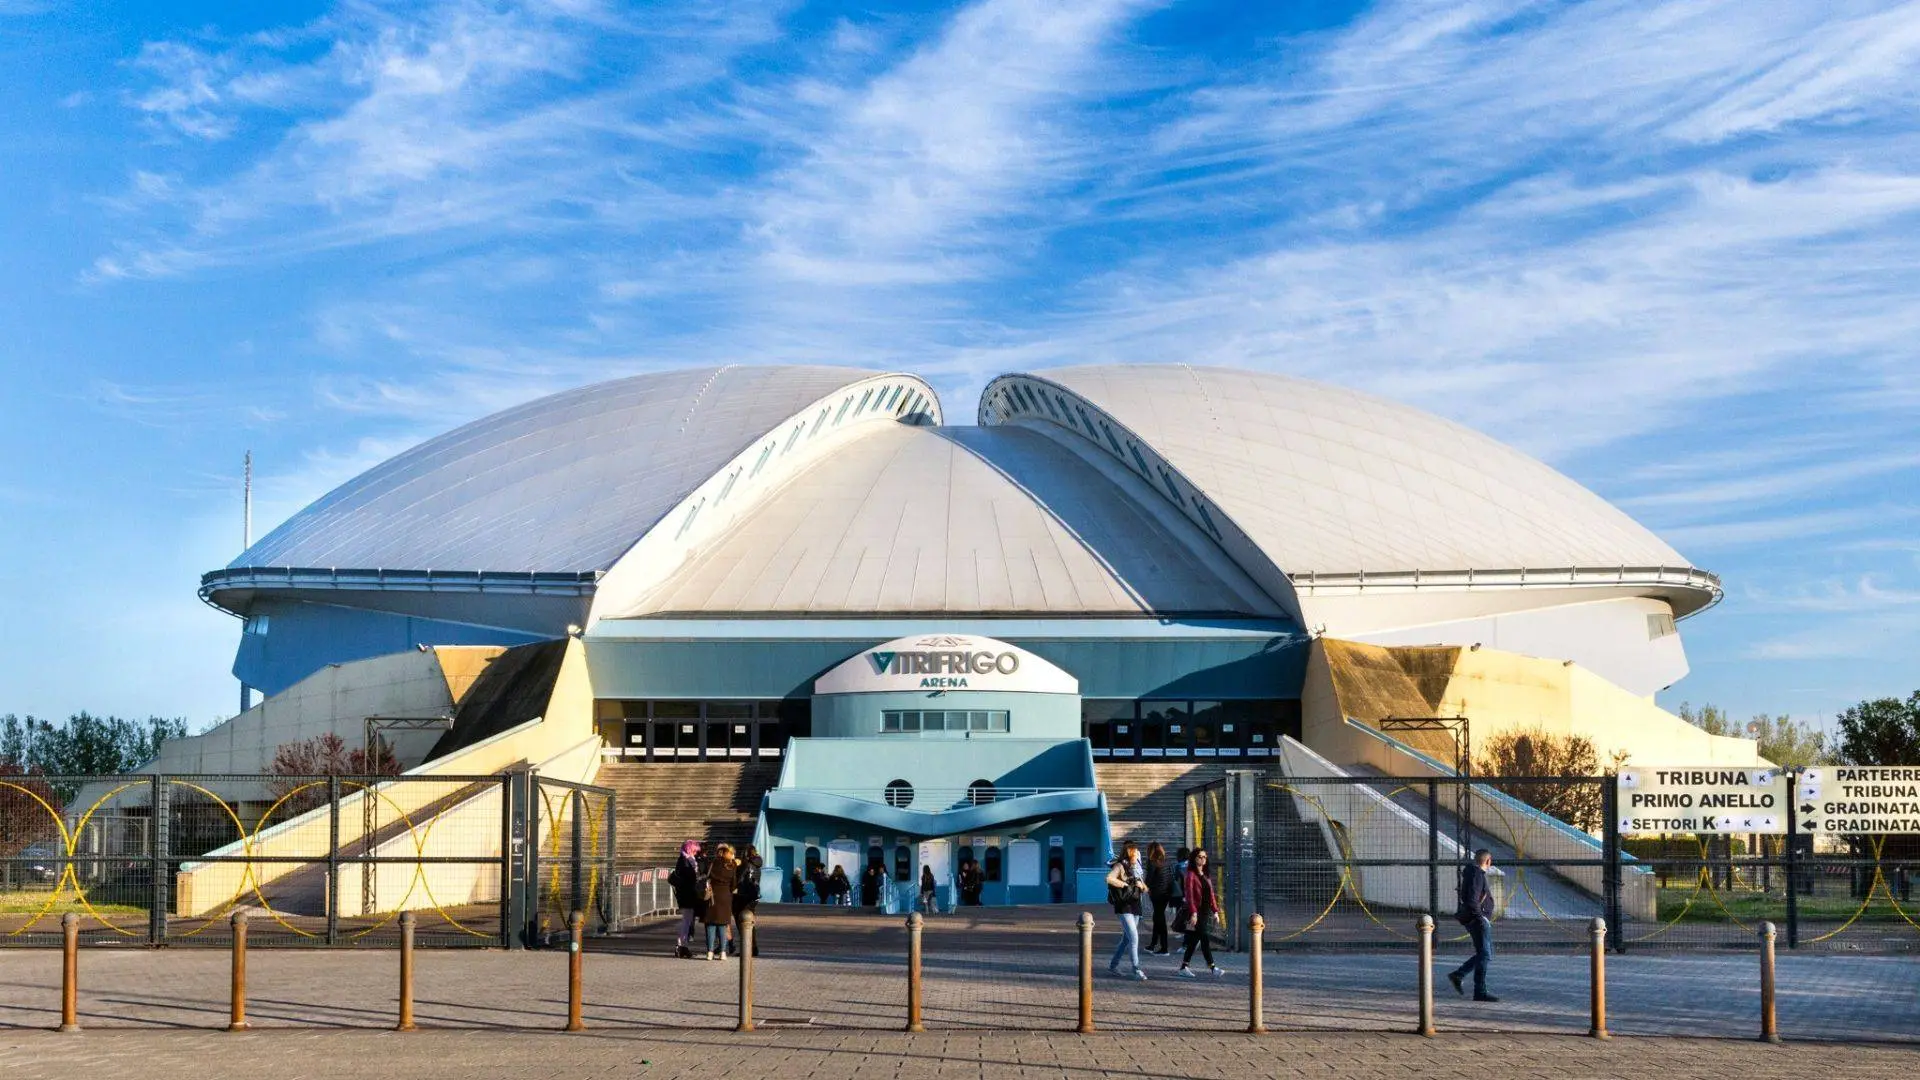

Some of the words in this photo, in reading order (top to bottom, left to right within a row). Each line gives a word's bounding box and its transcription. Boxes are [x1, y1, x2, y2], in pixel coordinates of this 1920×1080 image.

[871, 651, 1020, 675] VITRIFRIGO
[919, 677, 968, 688] ARENA
[1656, 771, 1749, 786] TRIBUNA
[1836, 769, 1920, 781] PARTERRE
[1842, 785, 1918, 797] TRIBUNA
[1631, 793, 1693, 808] PRIMO
[1699, 793, 1775, 808] ANELLO
[1823, 802, 1920, 814] GRADINATA
[1632, 818, 1697, 830] SETTORI
[1702, 815, 1716, 830] K
[1744, 819, 1751, 827] K
[1824, 819, 1920, 831] GRADINATA
